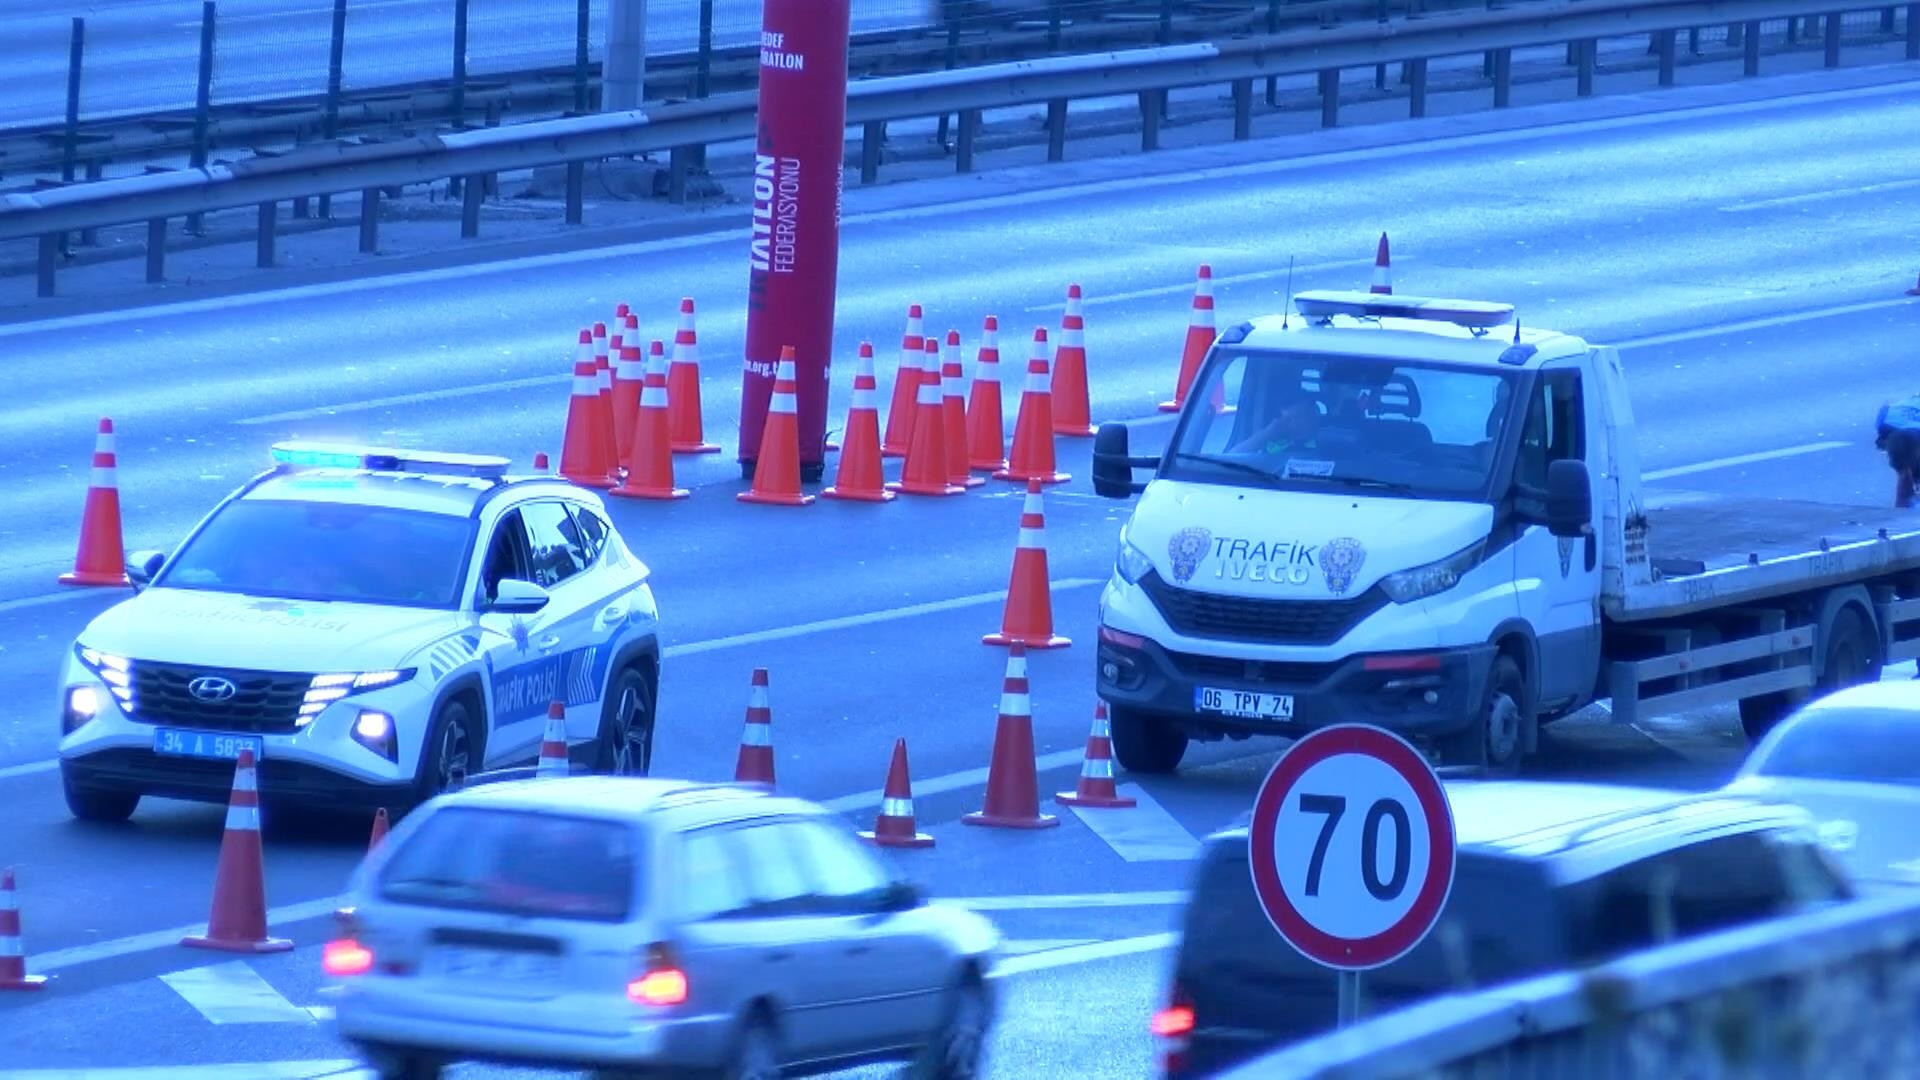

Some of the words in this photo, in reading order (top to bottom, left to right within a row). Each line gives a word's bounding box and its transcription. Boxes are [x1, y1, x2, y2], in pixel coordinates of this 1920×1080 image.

[1214, 536, 1319, 567] TRAFİK
[1214, 560, 1310, 586] IVECO
[1203, 689, 1222, 708] 06
[1272, 696, 1291, 716] 74
[164, 732, 184, 753] 34
[194, 735, 204, 753] A
[1299, 793, 1411, 902] 70
